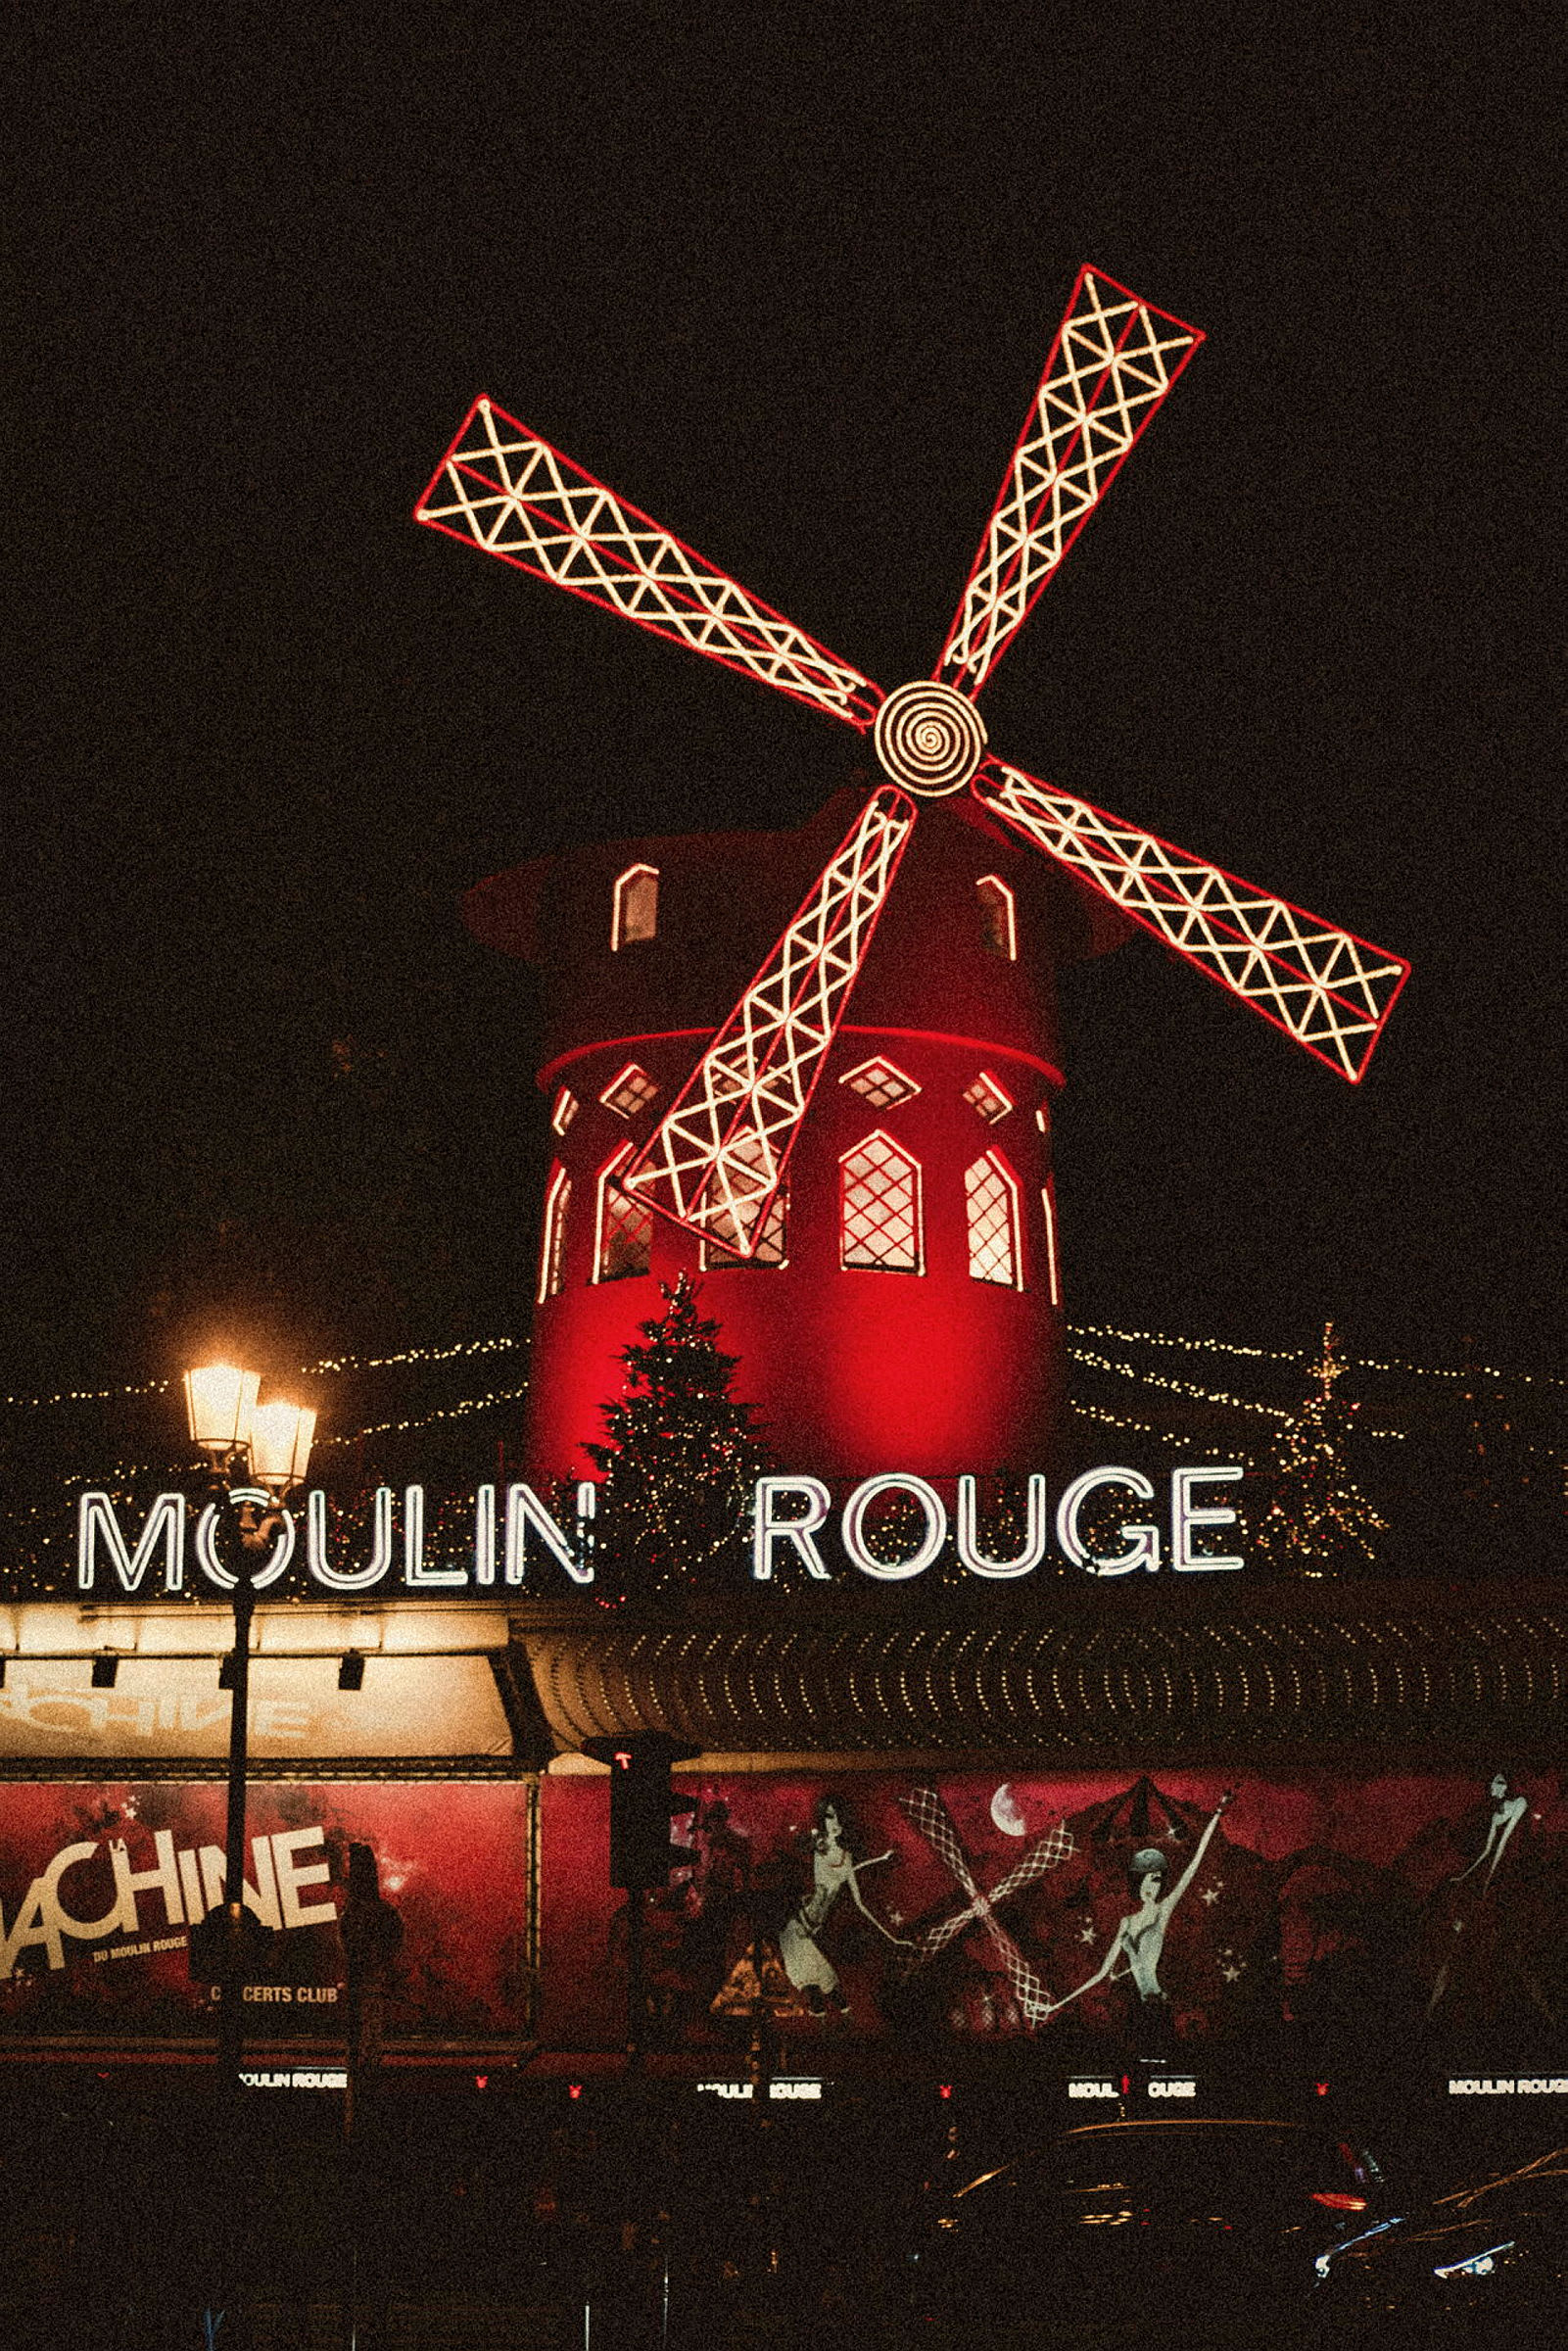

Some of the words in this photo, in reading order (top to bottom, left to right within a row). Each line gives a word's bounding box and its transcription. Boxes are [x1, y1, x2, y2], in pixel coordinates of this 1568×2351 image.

[78, 1481, 595, 1592] MOULIN
[751, 1465, 1245, 1581] ROUGE
[110, 1942, 151, 1960] MOULIN
[153, 1935, 188, 1952] ROUGE
[210, 1985, 293, 2002] CCERTS
[297, 1987, 339, 2003] CLUB
[238, 2073, 291, 2087] OULIN
[1449, 2079, 1515, 2094] MOULIN
